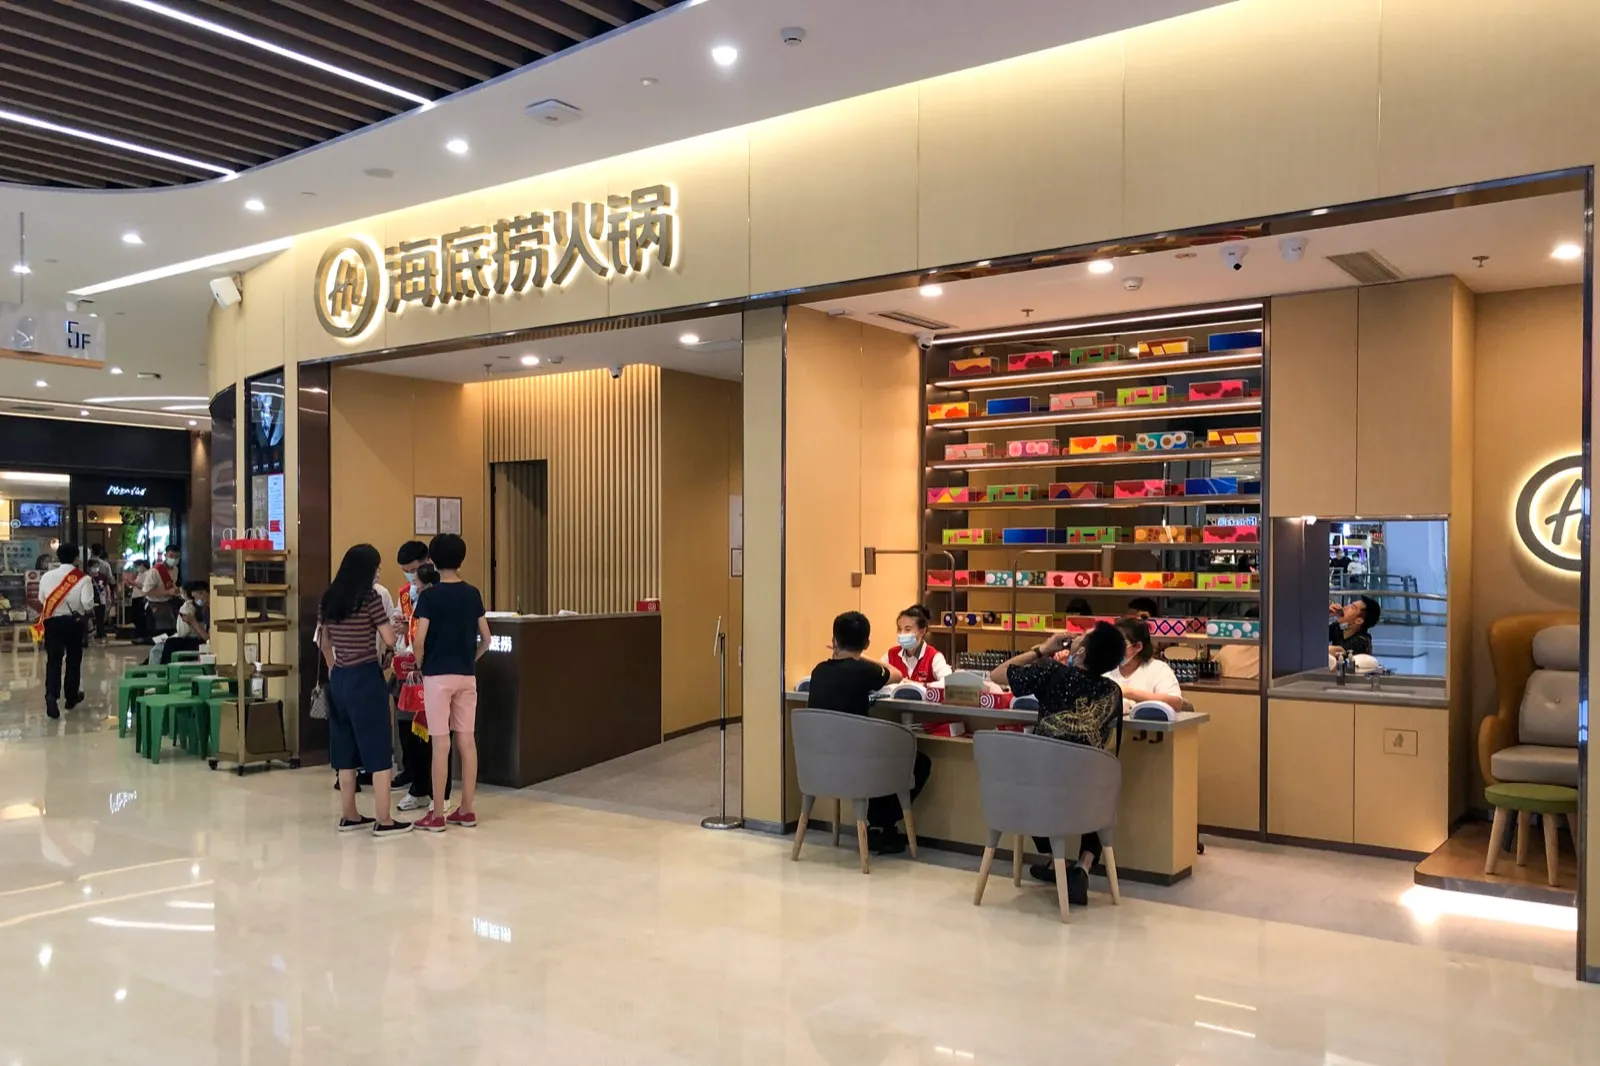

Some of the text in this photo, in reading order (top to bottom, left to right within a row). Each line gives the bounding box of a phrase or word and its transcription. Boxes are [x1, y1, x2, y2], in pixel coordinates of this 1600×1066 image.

[384, 183, 673, 314] 海底捞火锅
[67, 320, 91, 350] 5F
[476, 634, 512, 653] 底捞
